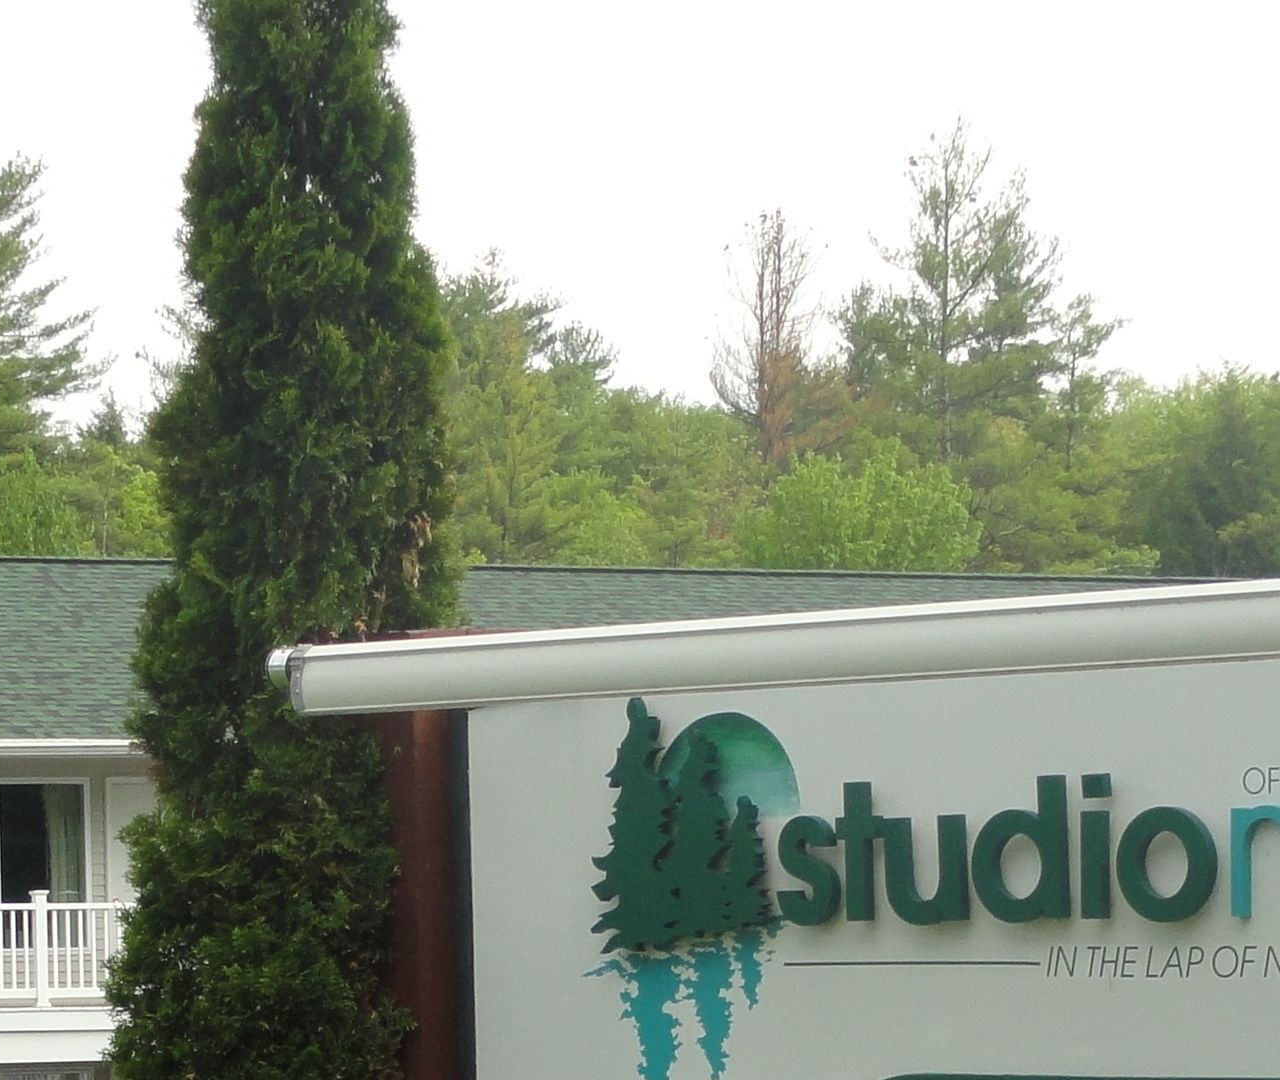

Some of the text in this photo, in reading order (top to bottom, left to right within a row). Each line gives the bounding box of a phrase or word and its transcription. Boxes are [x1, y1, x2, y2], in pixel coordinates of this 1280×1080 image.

[1242, 765, 1280, 795] OF
[1045, 945, 1078, 978] IN
[1086, 945, 1139, 978] THE
[1145, 945, 1205, 979] LAP
[1211, 945, 1258, 979] OF
